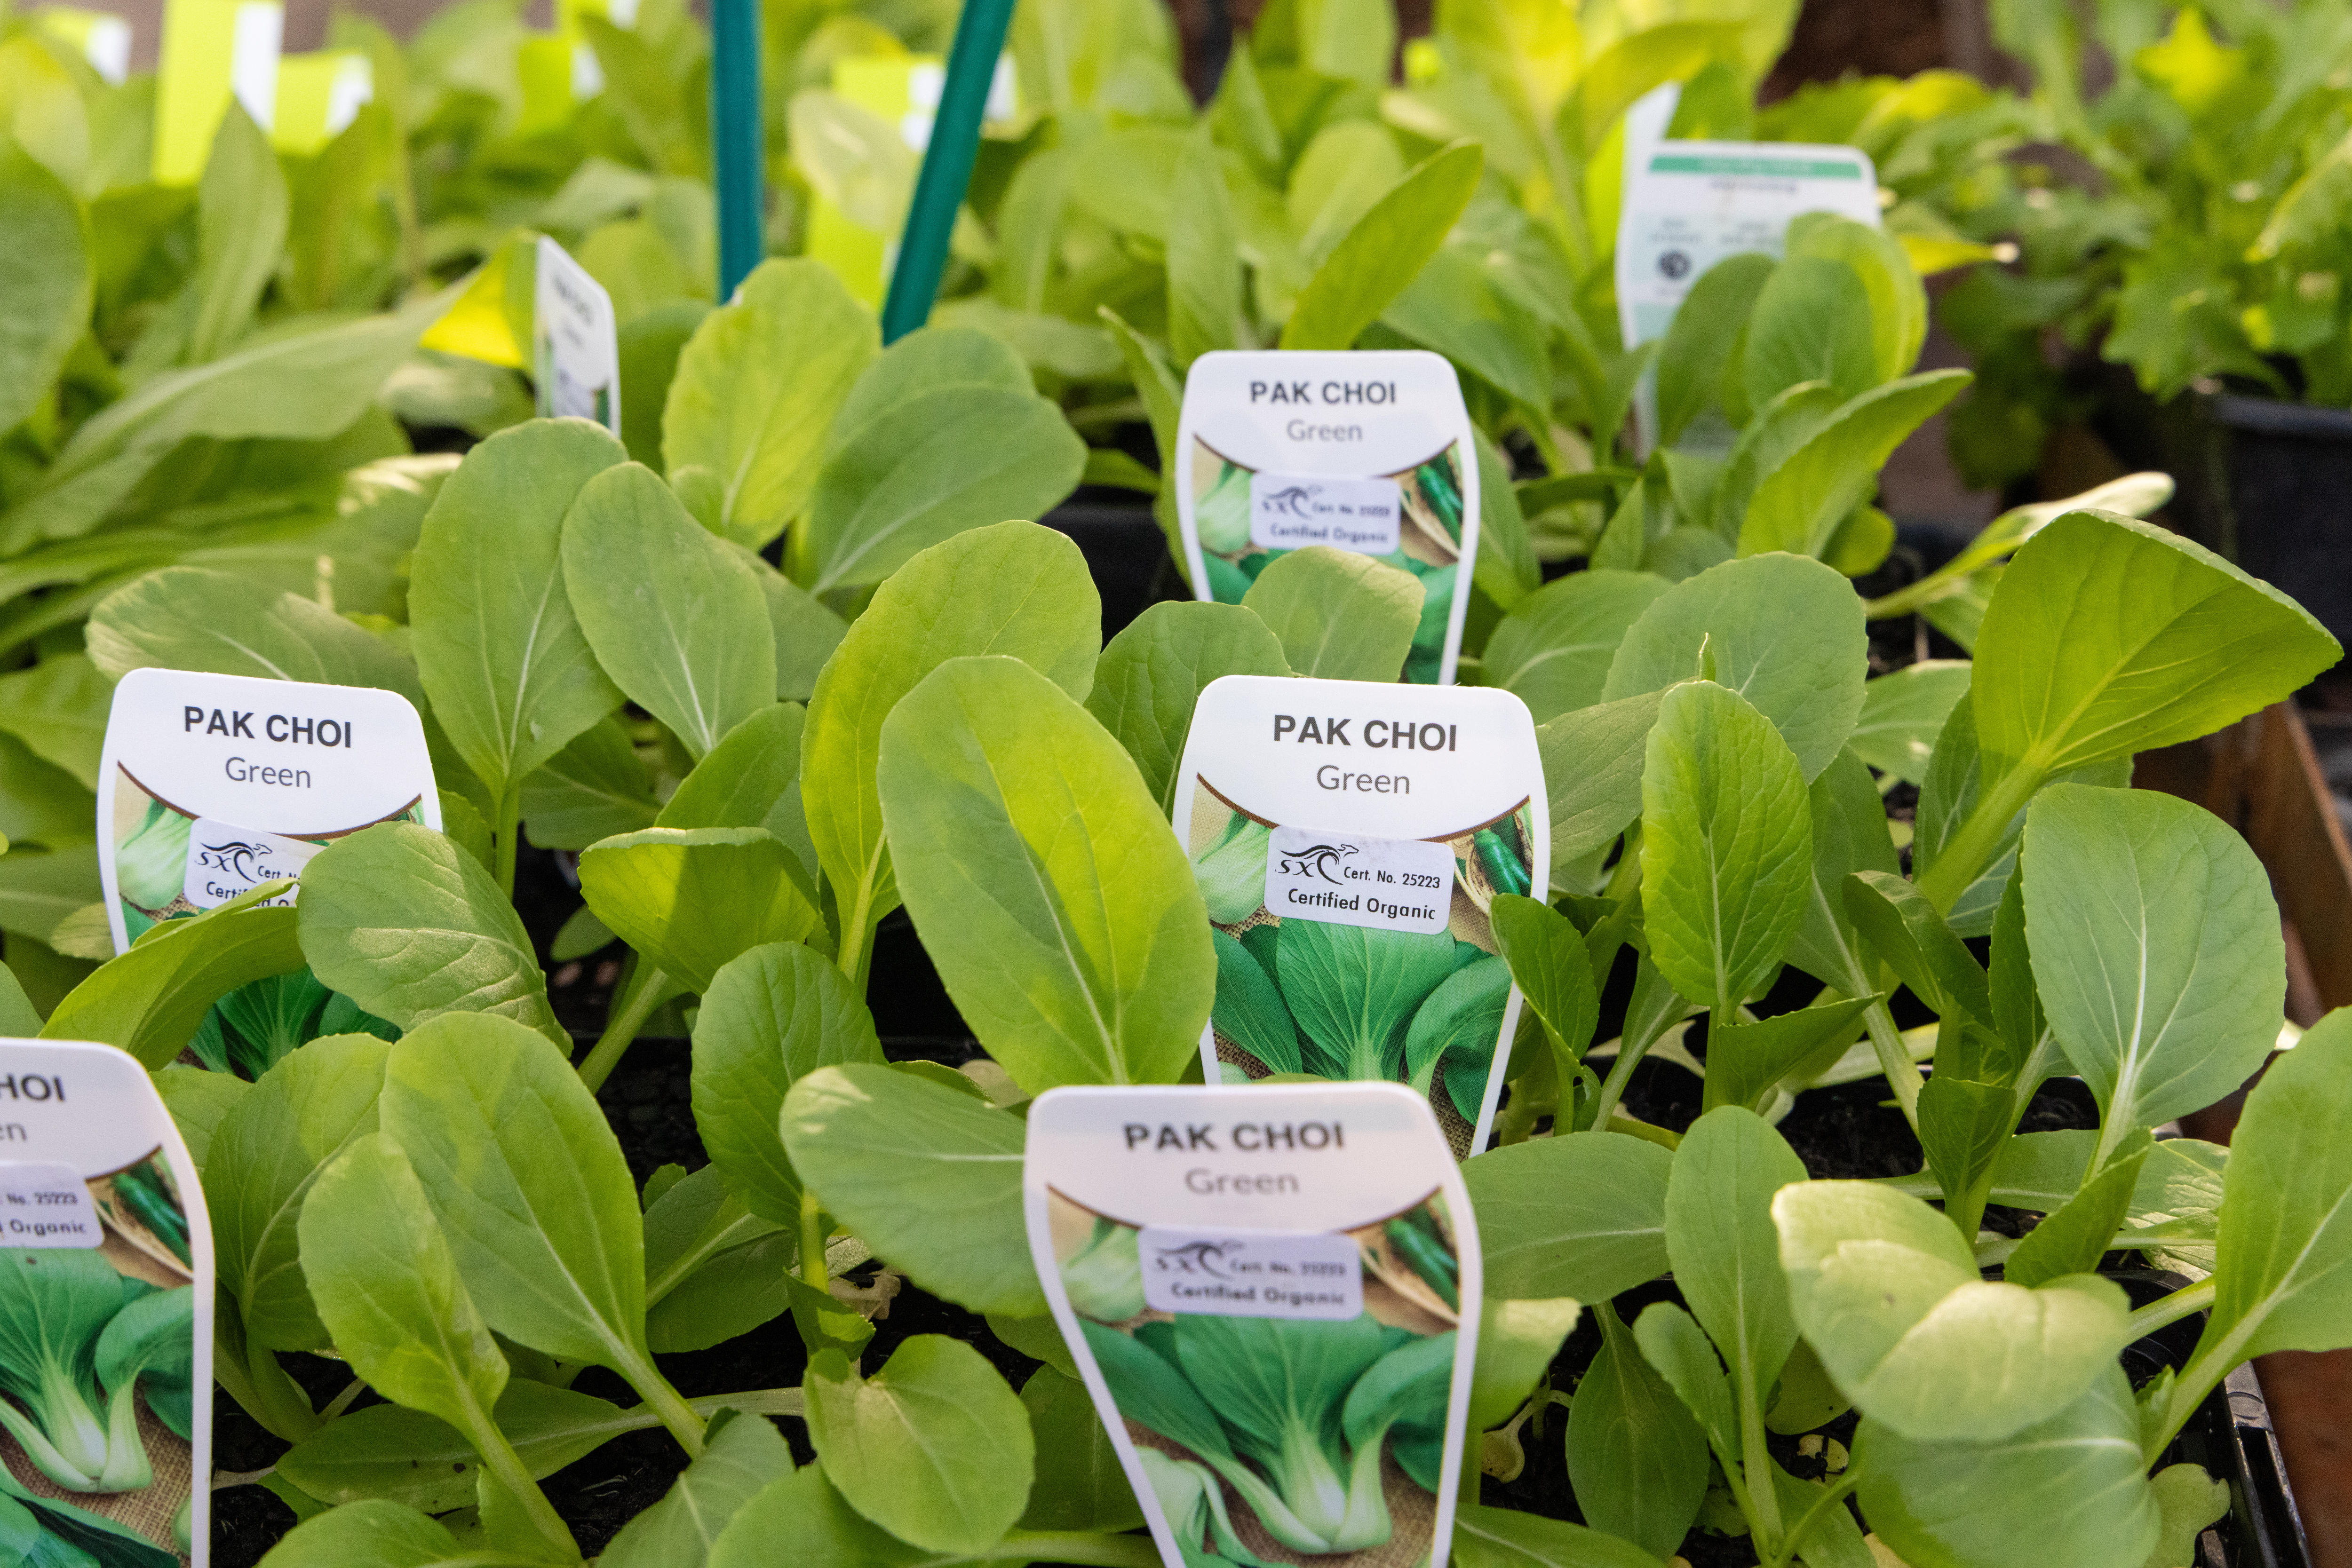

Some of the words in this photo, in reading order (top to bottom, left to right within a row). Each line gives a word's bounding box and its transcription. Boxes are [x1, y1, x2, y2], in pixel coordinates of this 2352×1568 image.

[1250, 381, 1311, 404] PAK
[1322, 381, 1396, 404] CHOI
[1287, 419, 1363, 442] Green
[185, 706, 255, 739] PAK
[266, 714, 351, 748] CHOI
[1274, 714, 1351, 746] PAK
[1364, 720, 1456, 752] CHOI
[225, 757, 311, 788] Green
[1317, 765, 1410, 794] Green
[258, 866, 281, 879] Cert
[1344, 867, 1371, 881] Cert.
[1377, 871, 1396, 883] No.
[1402, 873, 1440, 888] 25223
[1288, 888, 1359, 911] Certified
[1367, 898, 1436, 919] Organic
[1123, 1122, 1217, 1151] PAK
[1231, 1121, 1344, 1151] CHOI
[1184, 1167, 1299, 1195] Green
[10, 1218, 85, 1238] Organic
